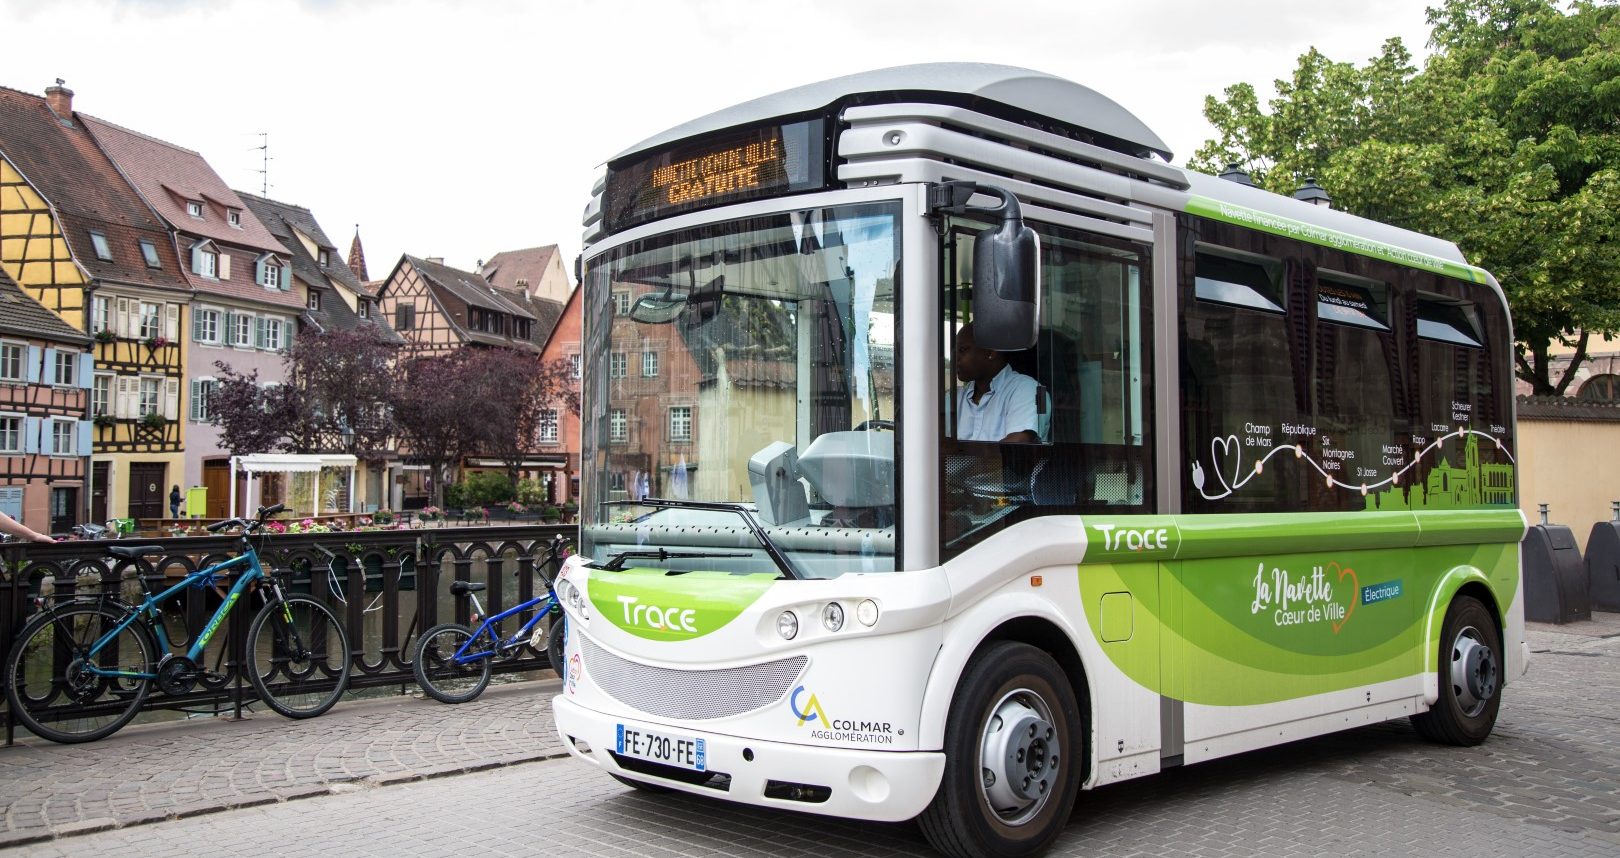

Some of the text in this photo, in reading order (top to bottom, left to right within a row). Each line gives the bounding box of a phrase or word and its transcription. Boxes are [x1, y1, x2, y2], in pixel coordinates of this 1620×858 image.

[653, 139, 777, 188] NAVETTE CENTRE VILLE
[669, 165, 759, 204] GRATUITE
[1451, 401, 1472, 411] Scheurer
[1245, 422, 1271, 435] Champ
[1281, 422, 1317, 436] République
[1245, 436, 1272, 447] de Mars
[1322, 435, 1330, 446] Six
[1412, 435, 1426, 445] Rapp
[1322, 448, 1355, 461] Montagnes
[1382, 444, 1403, 455] Marché
[1322, 460, 1341, 470] Noires
[1382, 456, 1404, 466] Couvert
[1356, 467, 1377, 477] St Josse
[1092, 524, 1168, 552] Trace
[1251, 562, 1333, 614] La Navette
[1365, 584, 1400, 603] Électrique
[616, 595, 698, 633] Trace
[1307, 605, 1321, 622] de
[1322, 602, 1345, 620] Ville
[832, 719, 892, 733] COLMAR
[811, 730, 892, 744] AGGLOMÉRATION
